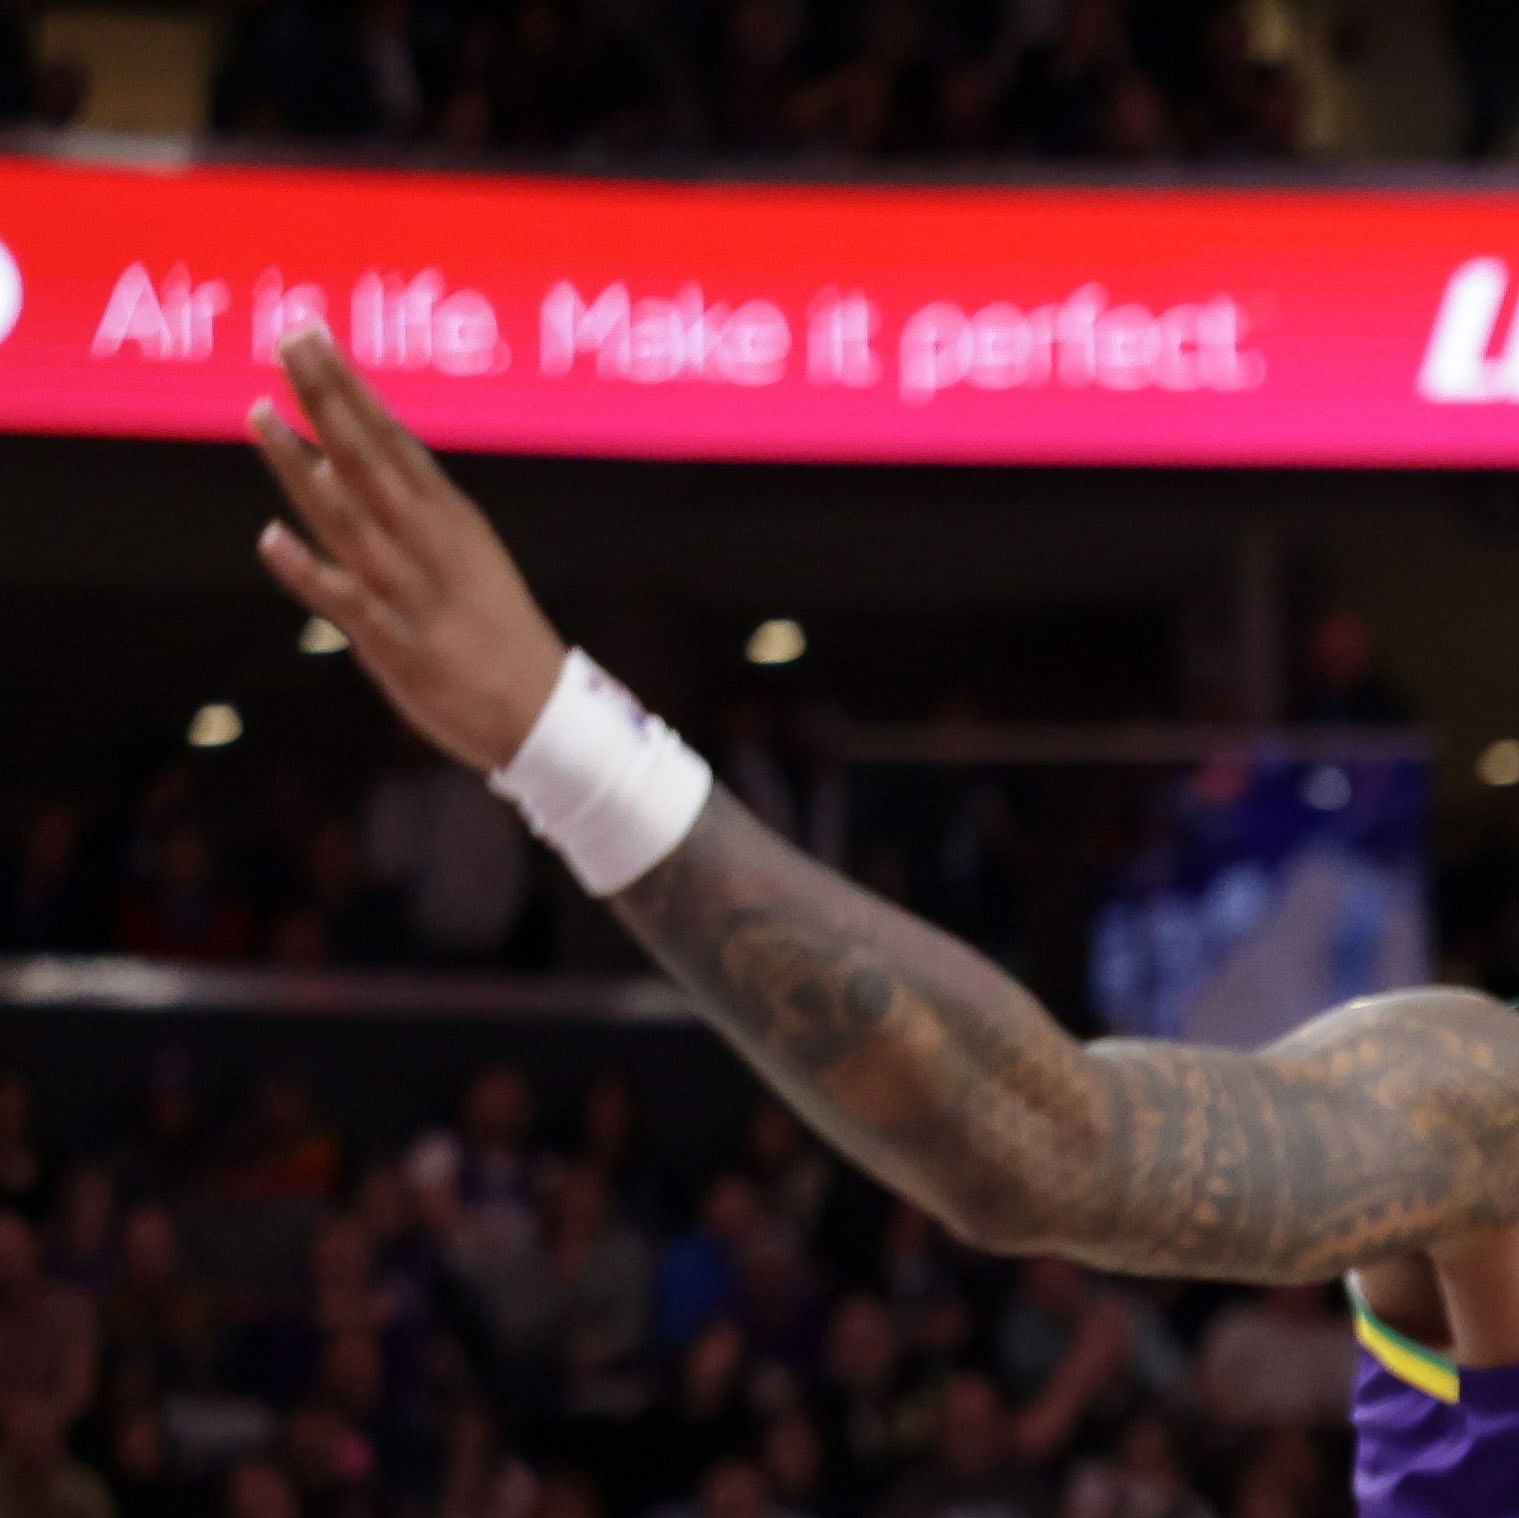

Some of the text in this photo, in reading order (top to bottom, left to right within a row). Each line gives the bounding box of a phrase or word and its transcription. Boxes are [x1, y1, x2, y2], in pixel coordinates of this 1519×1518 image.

[90, 261, 232, 362] Air
[350, 266, 511, 377] life.
[538, 279, 791, 386] Make
[806, 284, 883, 389] it
[900, 281, 1267, 405] perfect.
